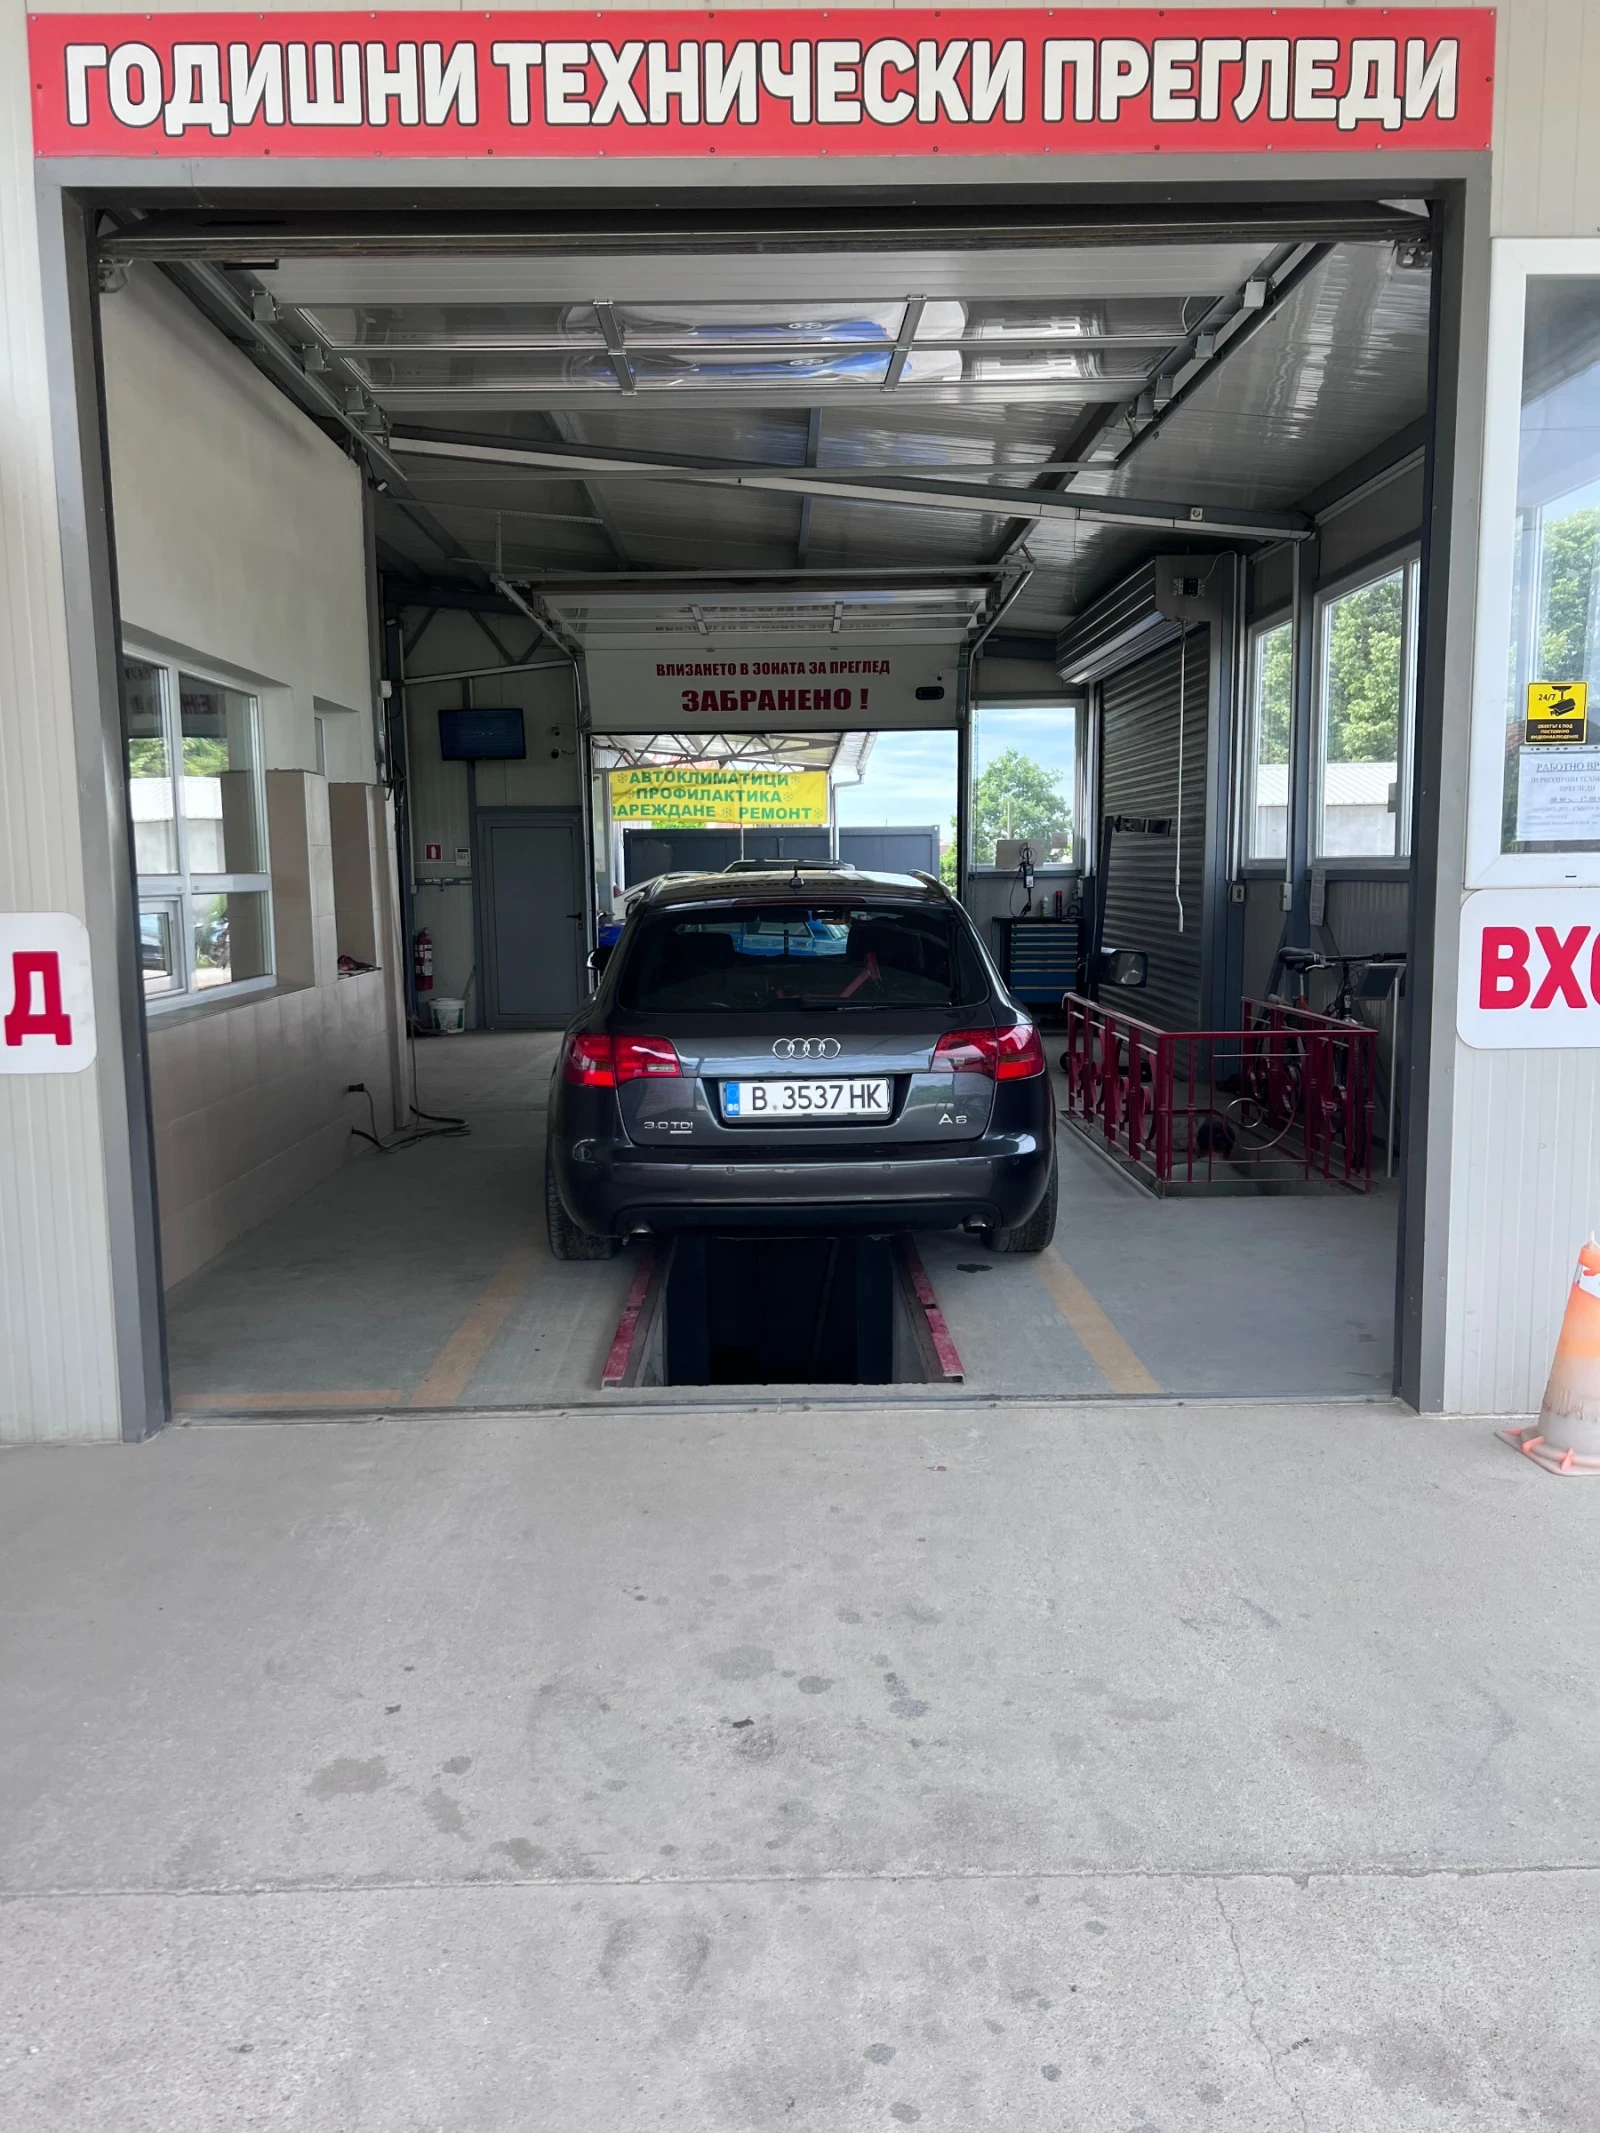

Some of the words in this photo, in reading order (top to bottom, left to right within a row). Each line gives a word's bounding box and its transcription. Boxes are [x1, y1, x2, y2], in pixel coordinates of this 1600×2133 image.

[64, 41, 478, 137] ГОДИШНИ
[490, 38, 1026, 126] ТЕХНИЧЕСКИ
[1042, 37, 1460, 131] ПРЕГЛЕДИ
[656, 663, 737, 676] ВЛИЗАНЕТО
[740, 662, 749, 676] В
[752, 661, 806, 676] ЗОНАТА
[809, 661, 826, 675] ЗА
[830, 660, 890, 675] ПРЕГЛЕД
[681, 688, 852, 712] ЗАБРАНЕНО
[1538, 693, 1556, 701] 24/7
[1536, 763, 1584, 772] РАБОТНО
[629, 770, 788, 786] АВТОКЛИМАТИЦИ
[636, 787, 782, 803] ПРОФИЛАКТИКА
[739, 807, 812, 819] РЕМОНТ
[1479, 925, 1600, 1009] ВХ
[5, 951, 72, 1046] Д
[752, 1086, 768, 1111] B
[782, 1084, 843, 1110] 3537
[849, 1084, 882, 1109] HK
[727, 1103, 739, 1112] BG
[644, 1121, 668, 1129] 3.0
[670, 1121, 693, 1129] TDI
[938, 1113, 967, 1124] A6
